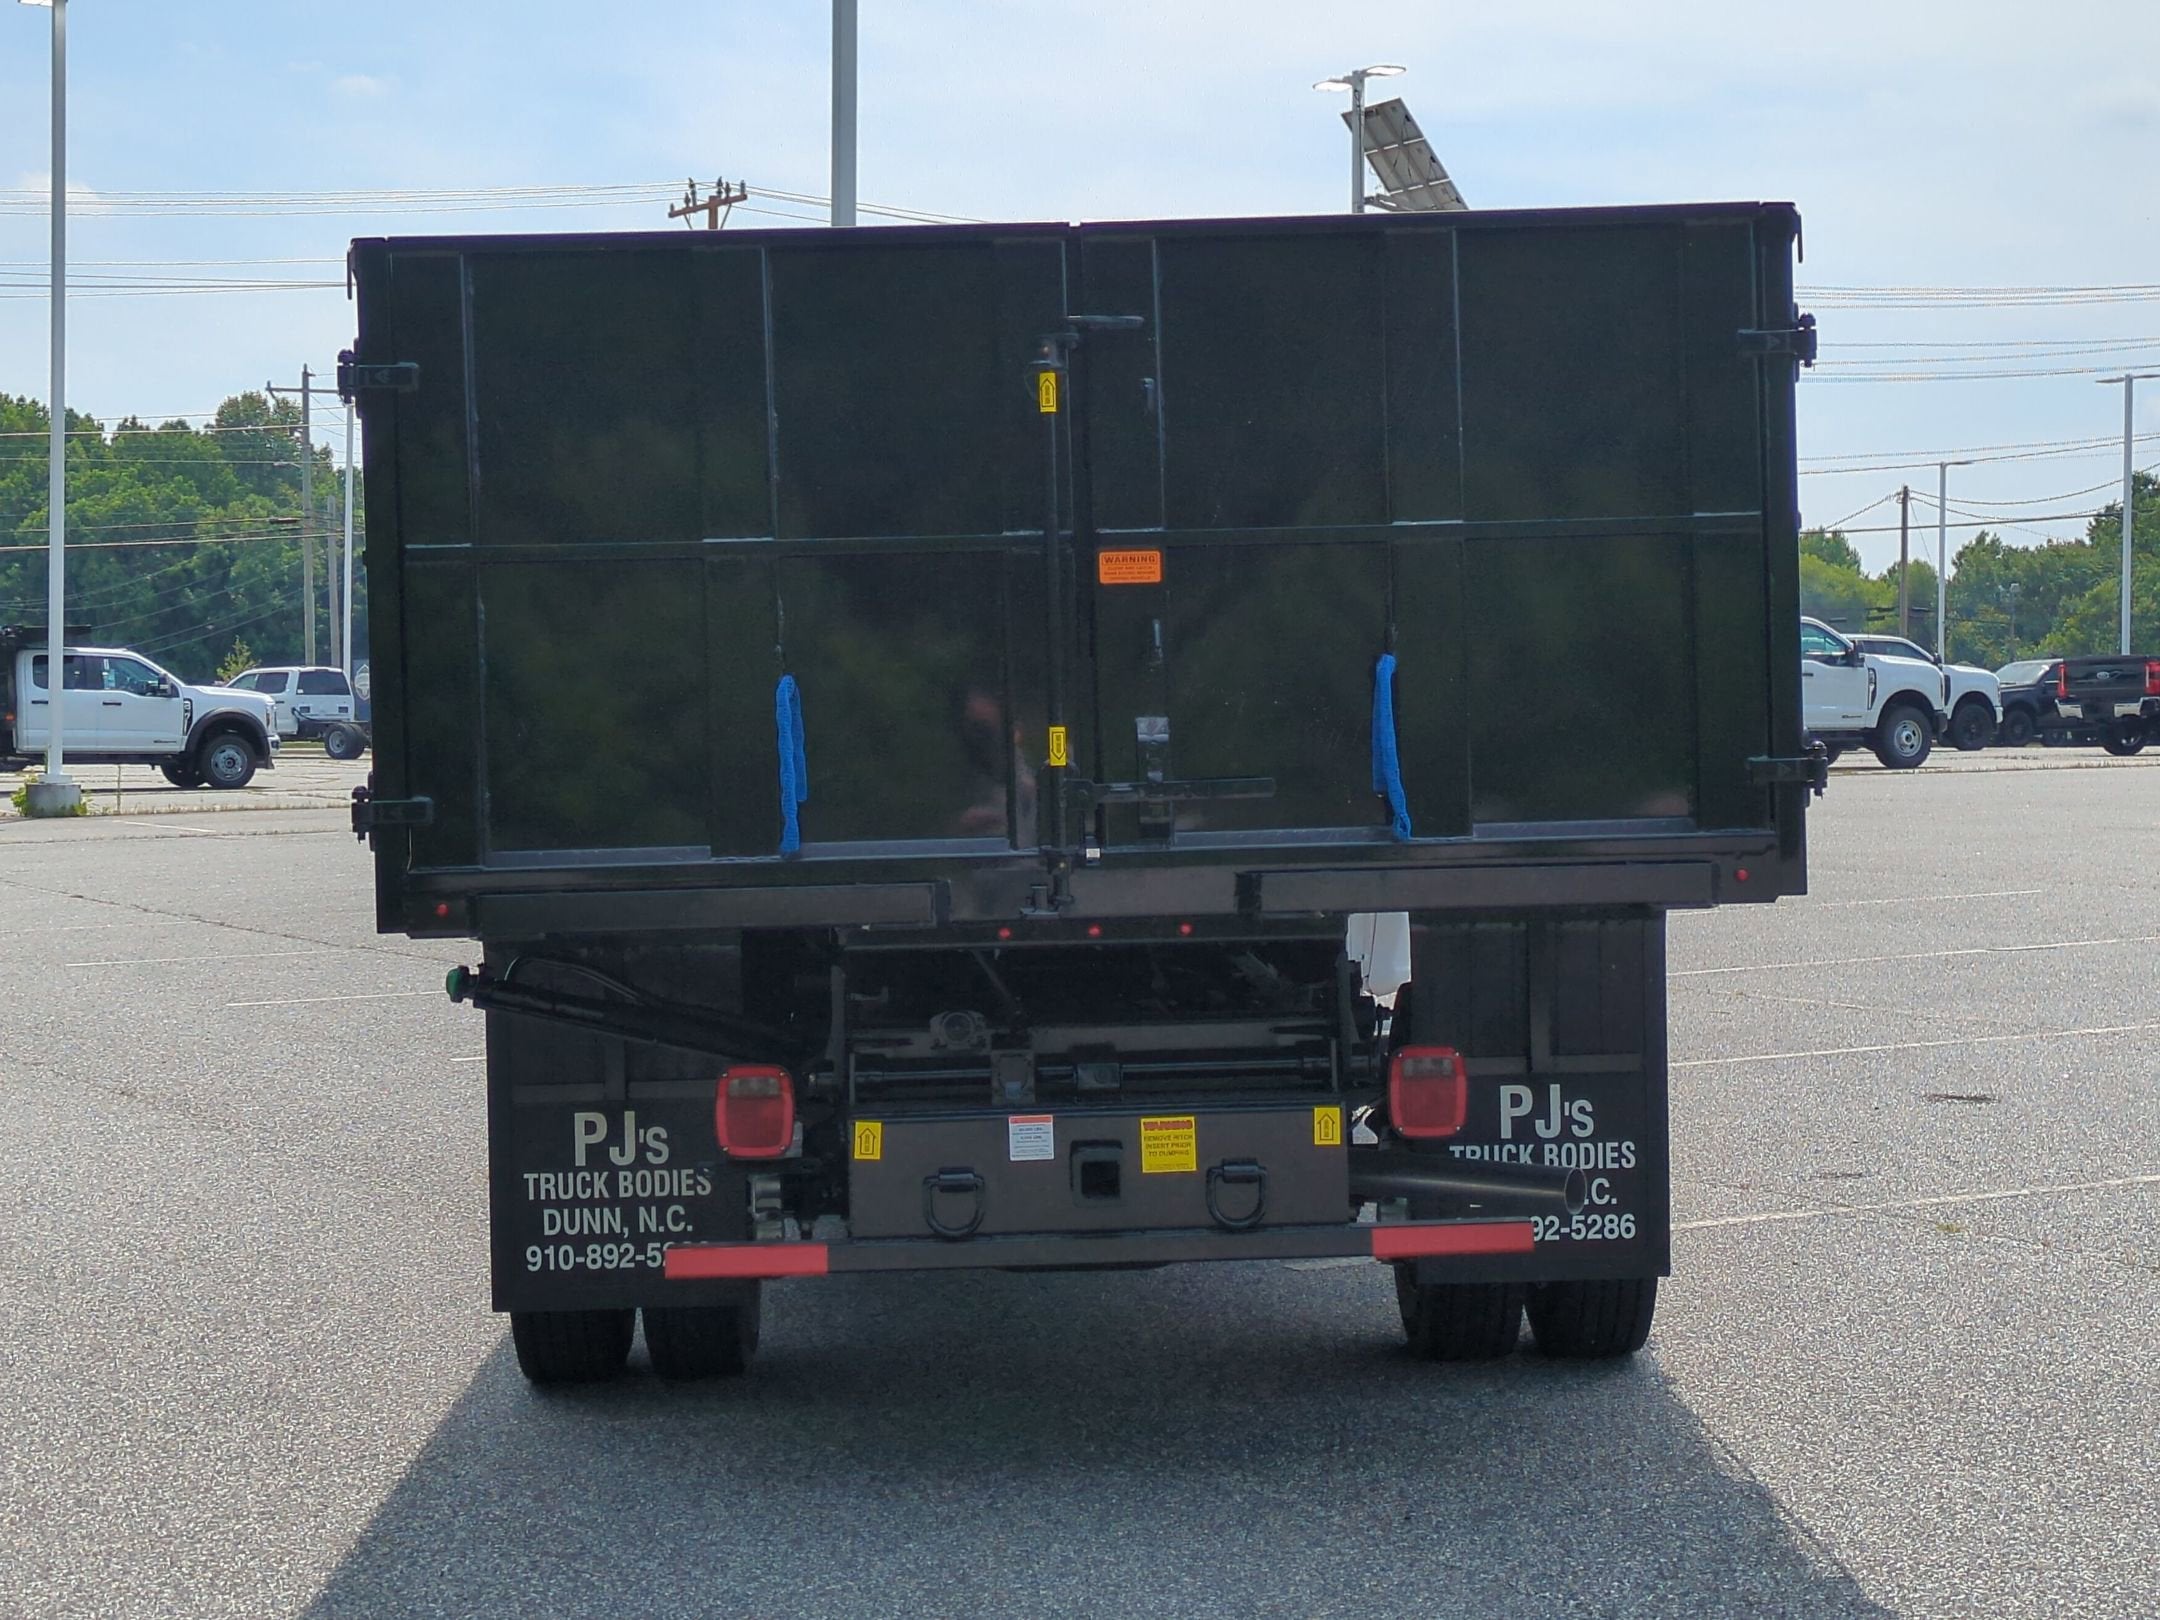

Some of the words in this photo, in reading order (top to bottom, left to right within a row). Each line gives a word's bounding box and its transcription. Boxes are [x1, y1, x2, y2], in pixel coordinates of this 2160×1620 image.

[1103, 555, 1156, 564] WARNING
[1543, 1140, 1637, 1170] BODIES
[523, 1170, 610, 1201] TRUCK
[618, 1168, 712, 1197] BODIES
[542, 1206, 630, 1238] DUNN,
[638, 1204, 694, 1233] N.C.
[1531, 1213, 1637, 1242] 92-5286
[525, 1240, 709, 1272] 910-892-5
